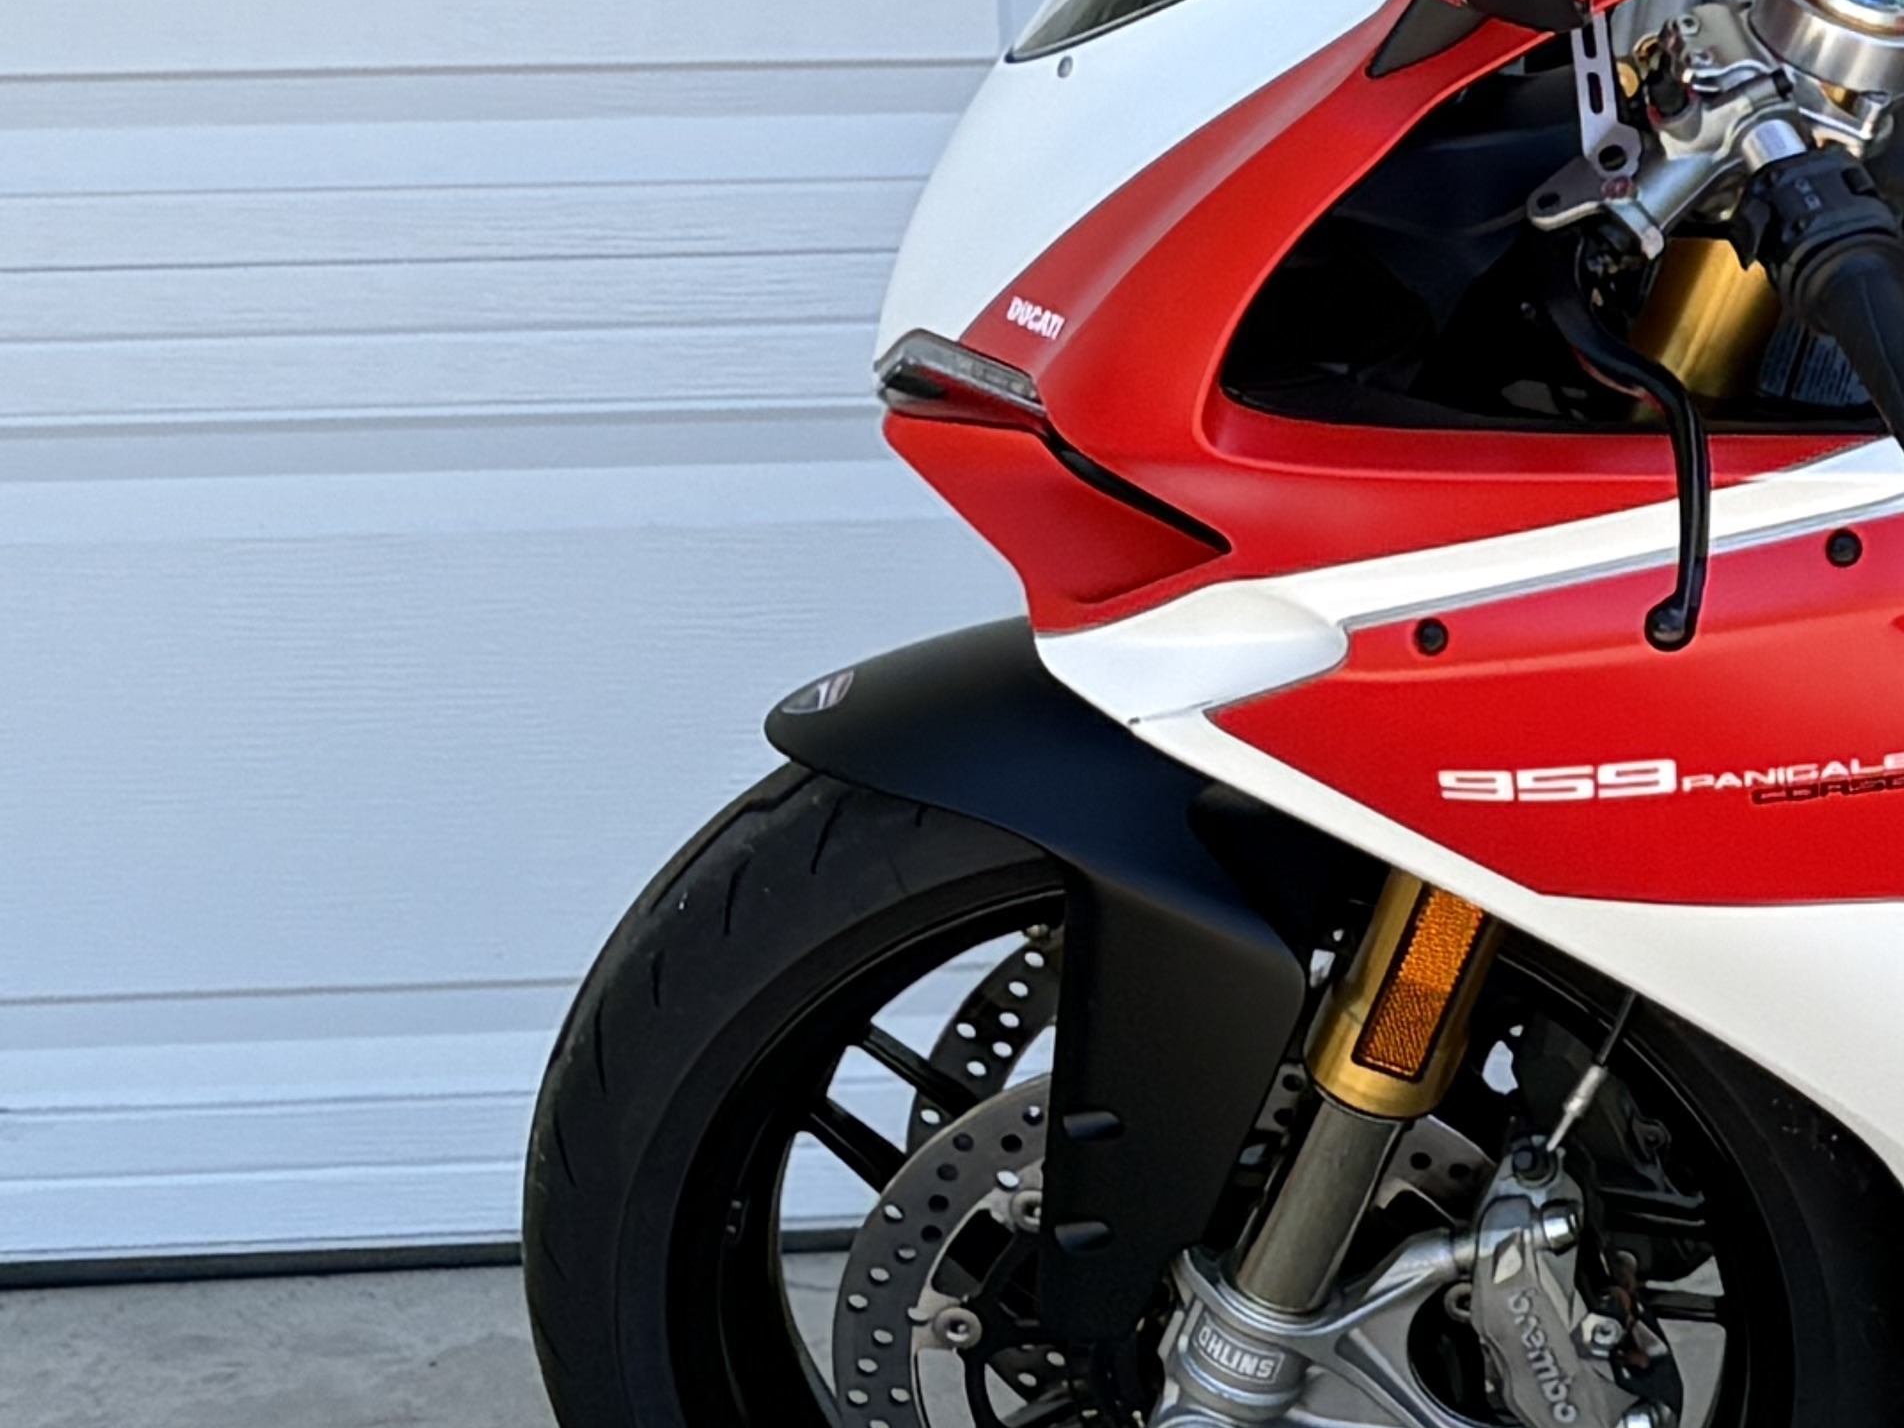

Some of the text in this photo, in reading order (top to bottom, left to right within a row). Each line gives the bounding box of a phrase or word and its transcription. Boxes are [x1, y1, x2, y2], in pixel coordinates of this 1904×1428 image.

[1006, 296, 1065, 341] DUCATI
[1438, 759, 1677, 802] 959
[1508, 1289, 1577, 1424] brembo
